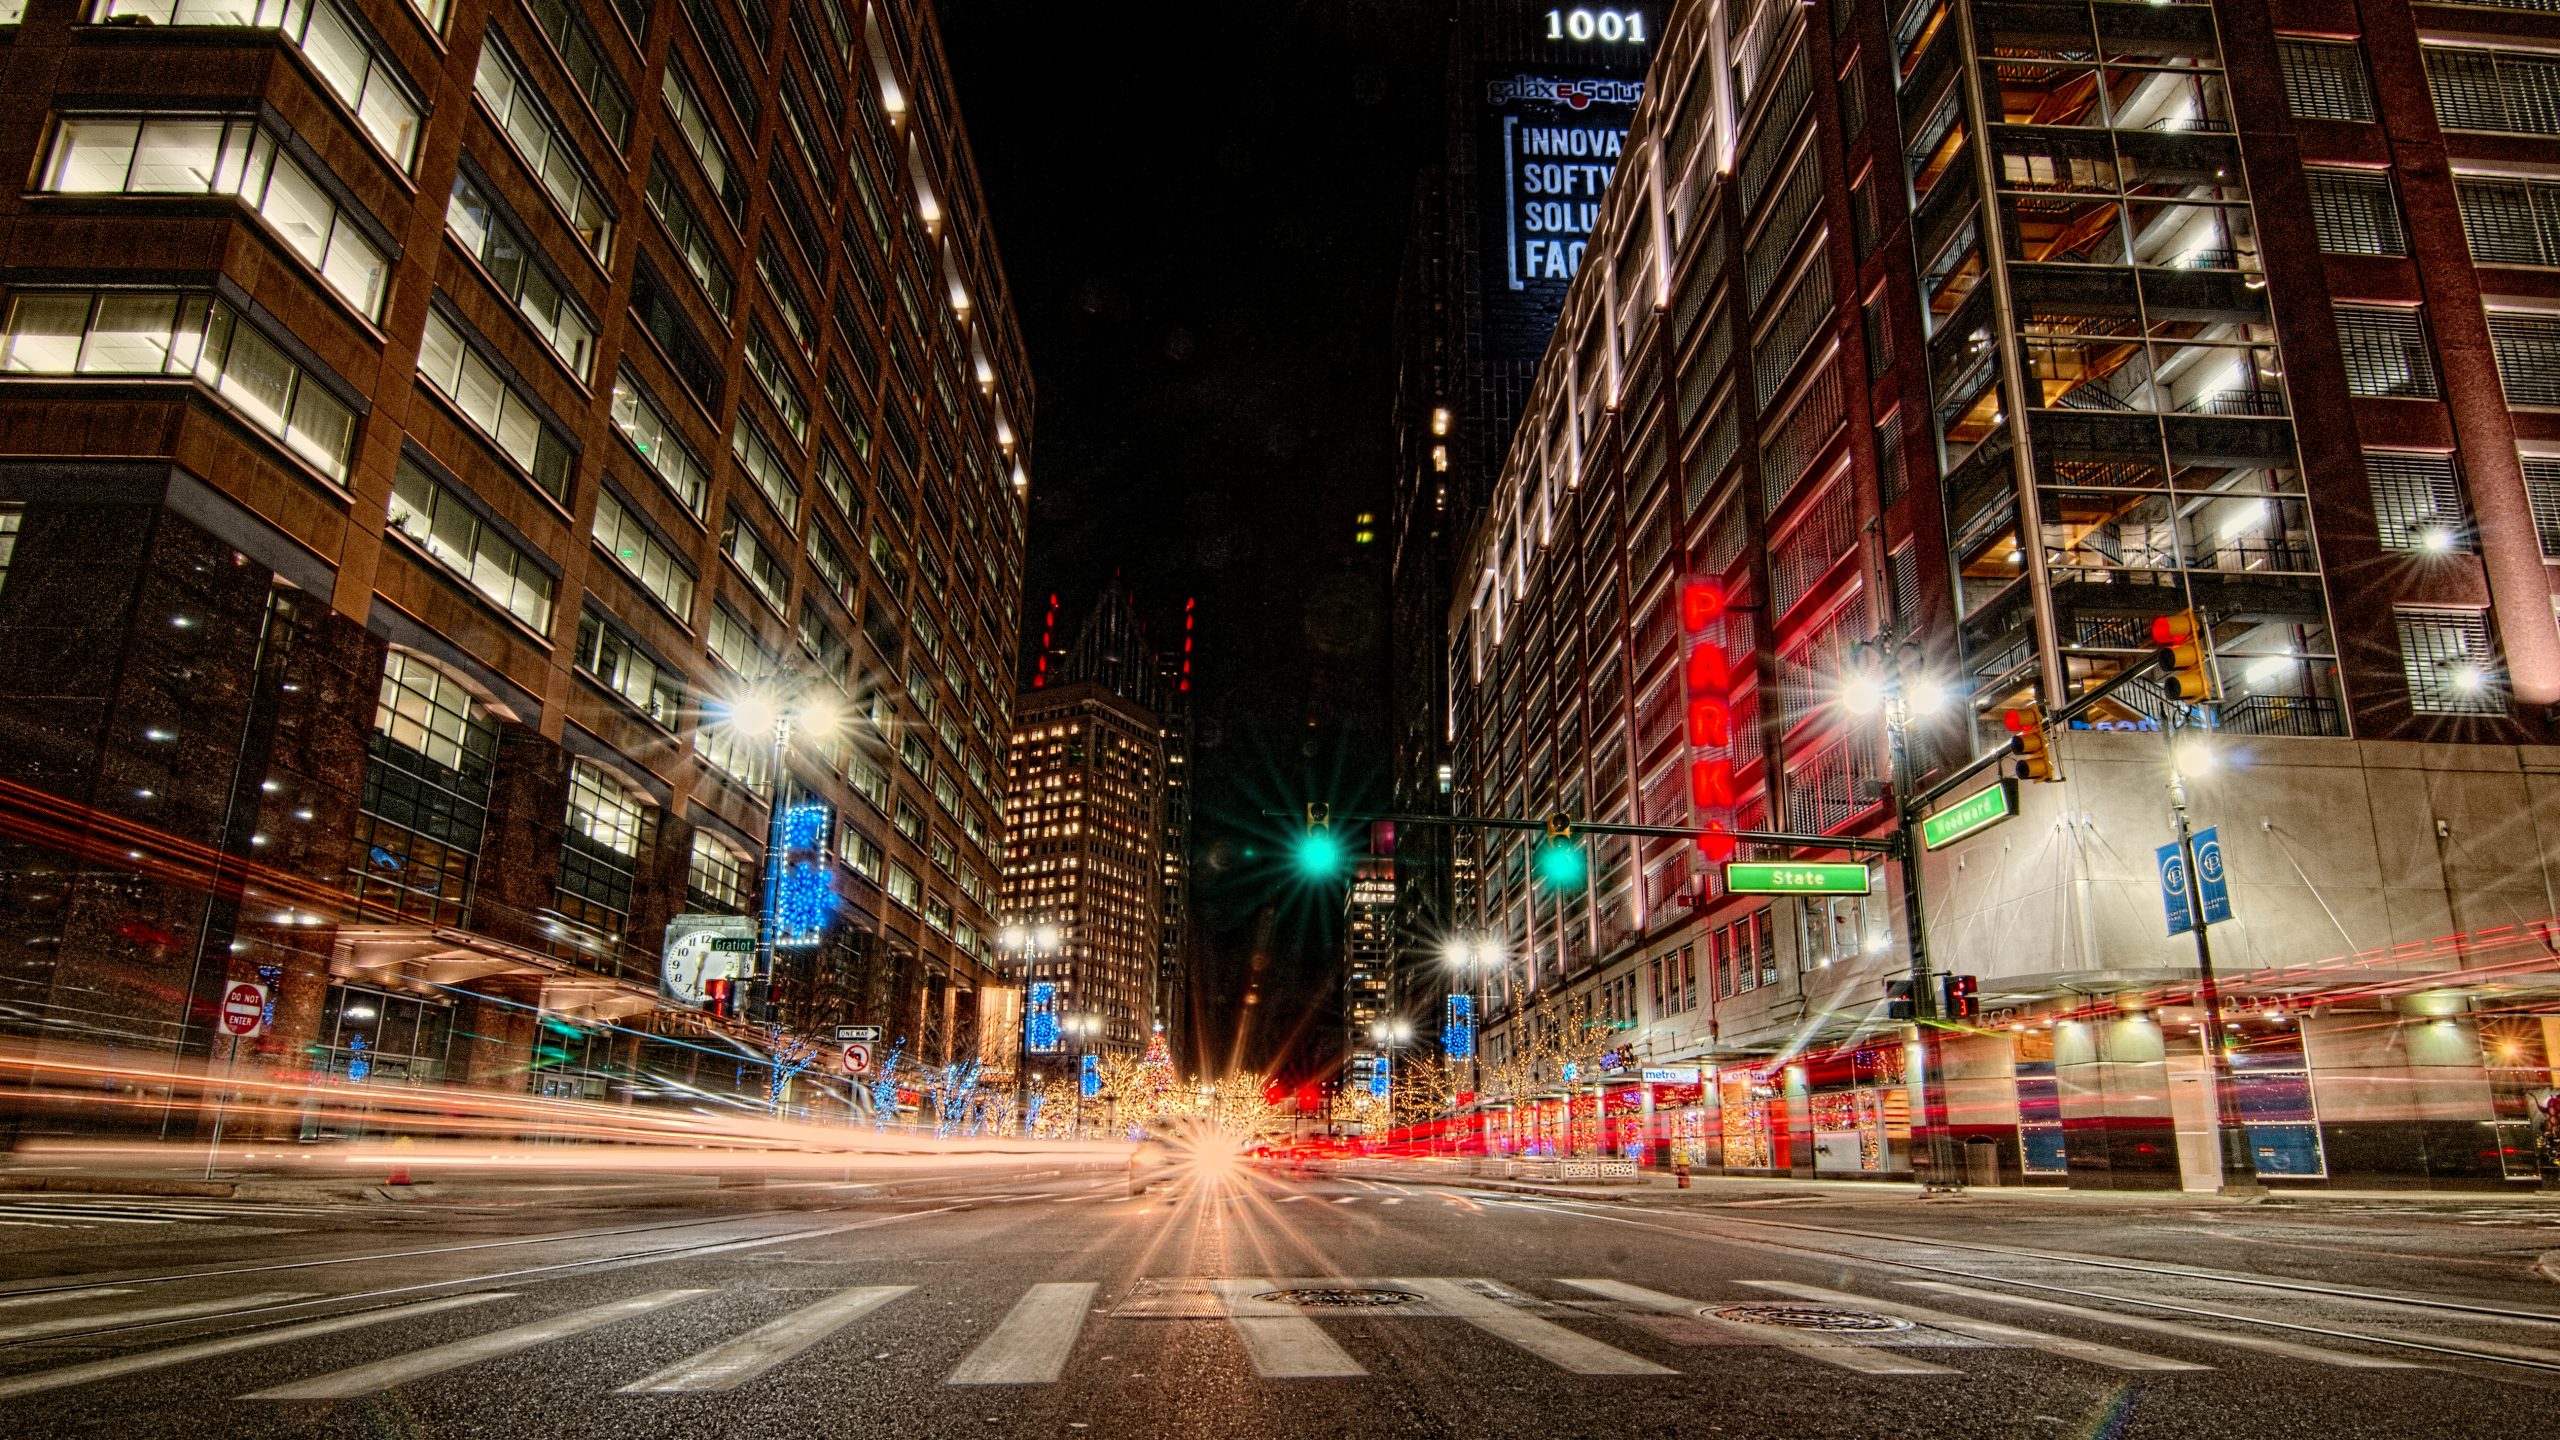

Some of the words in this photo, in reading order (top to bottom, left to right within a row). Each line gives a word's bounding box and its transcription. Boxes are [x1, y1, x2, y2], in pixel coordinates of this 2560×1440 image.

[1545, 10, 1645, 42] 1001
[1525, 202, 1602, 234] SOLU
[1684, 584, 1734, 808] PARK
[1936, 797, 1991, 835] Woodward
[1772, 870, 1825, 885] State
[715, 940, 751, 951] Gratiot
[678, 948, 689, 957] 10
[672, 960, 680, 970] 9
[674, 974, 682, 983] 8
[685, 984, 693, 993] 7
[231, 992, 241, 1001] DO
[244, 994, 259, 1004] NOT
[229, 1015, 252, 1026] ENTER
[1645, 1070, 1676, 1079] metro
